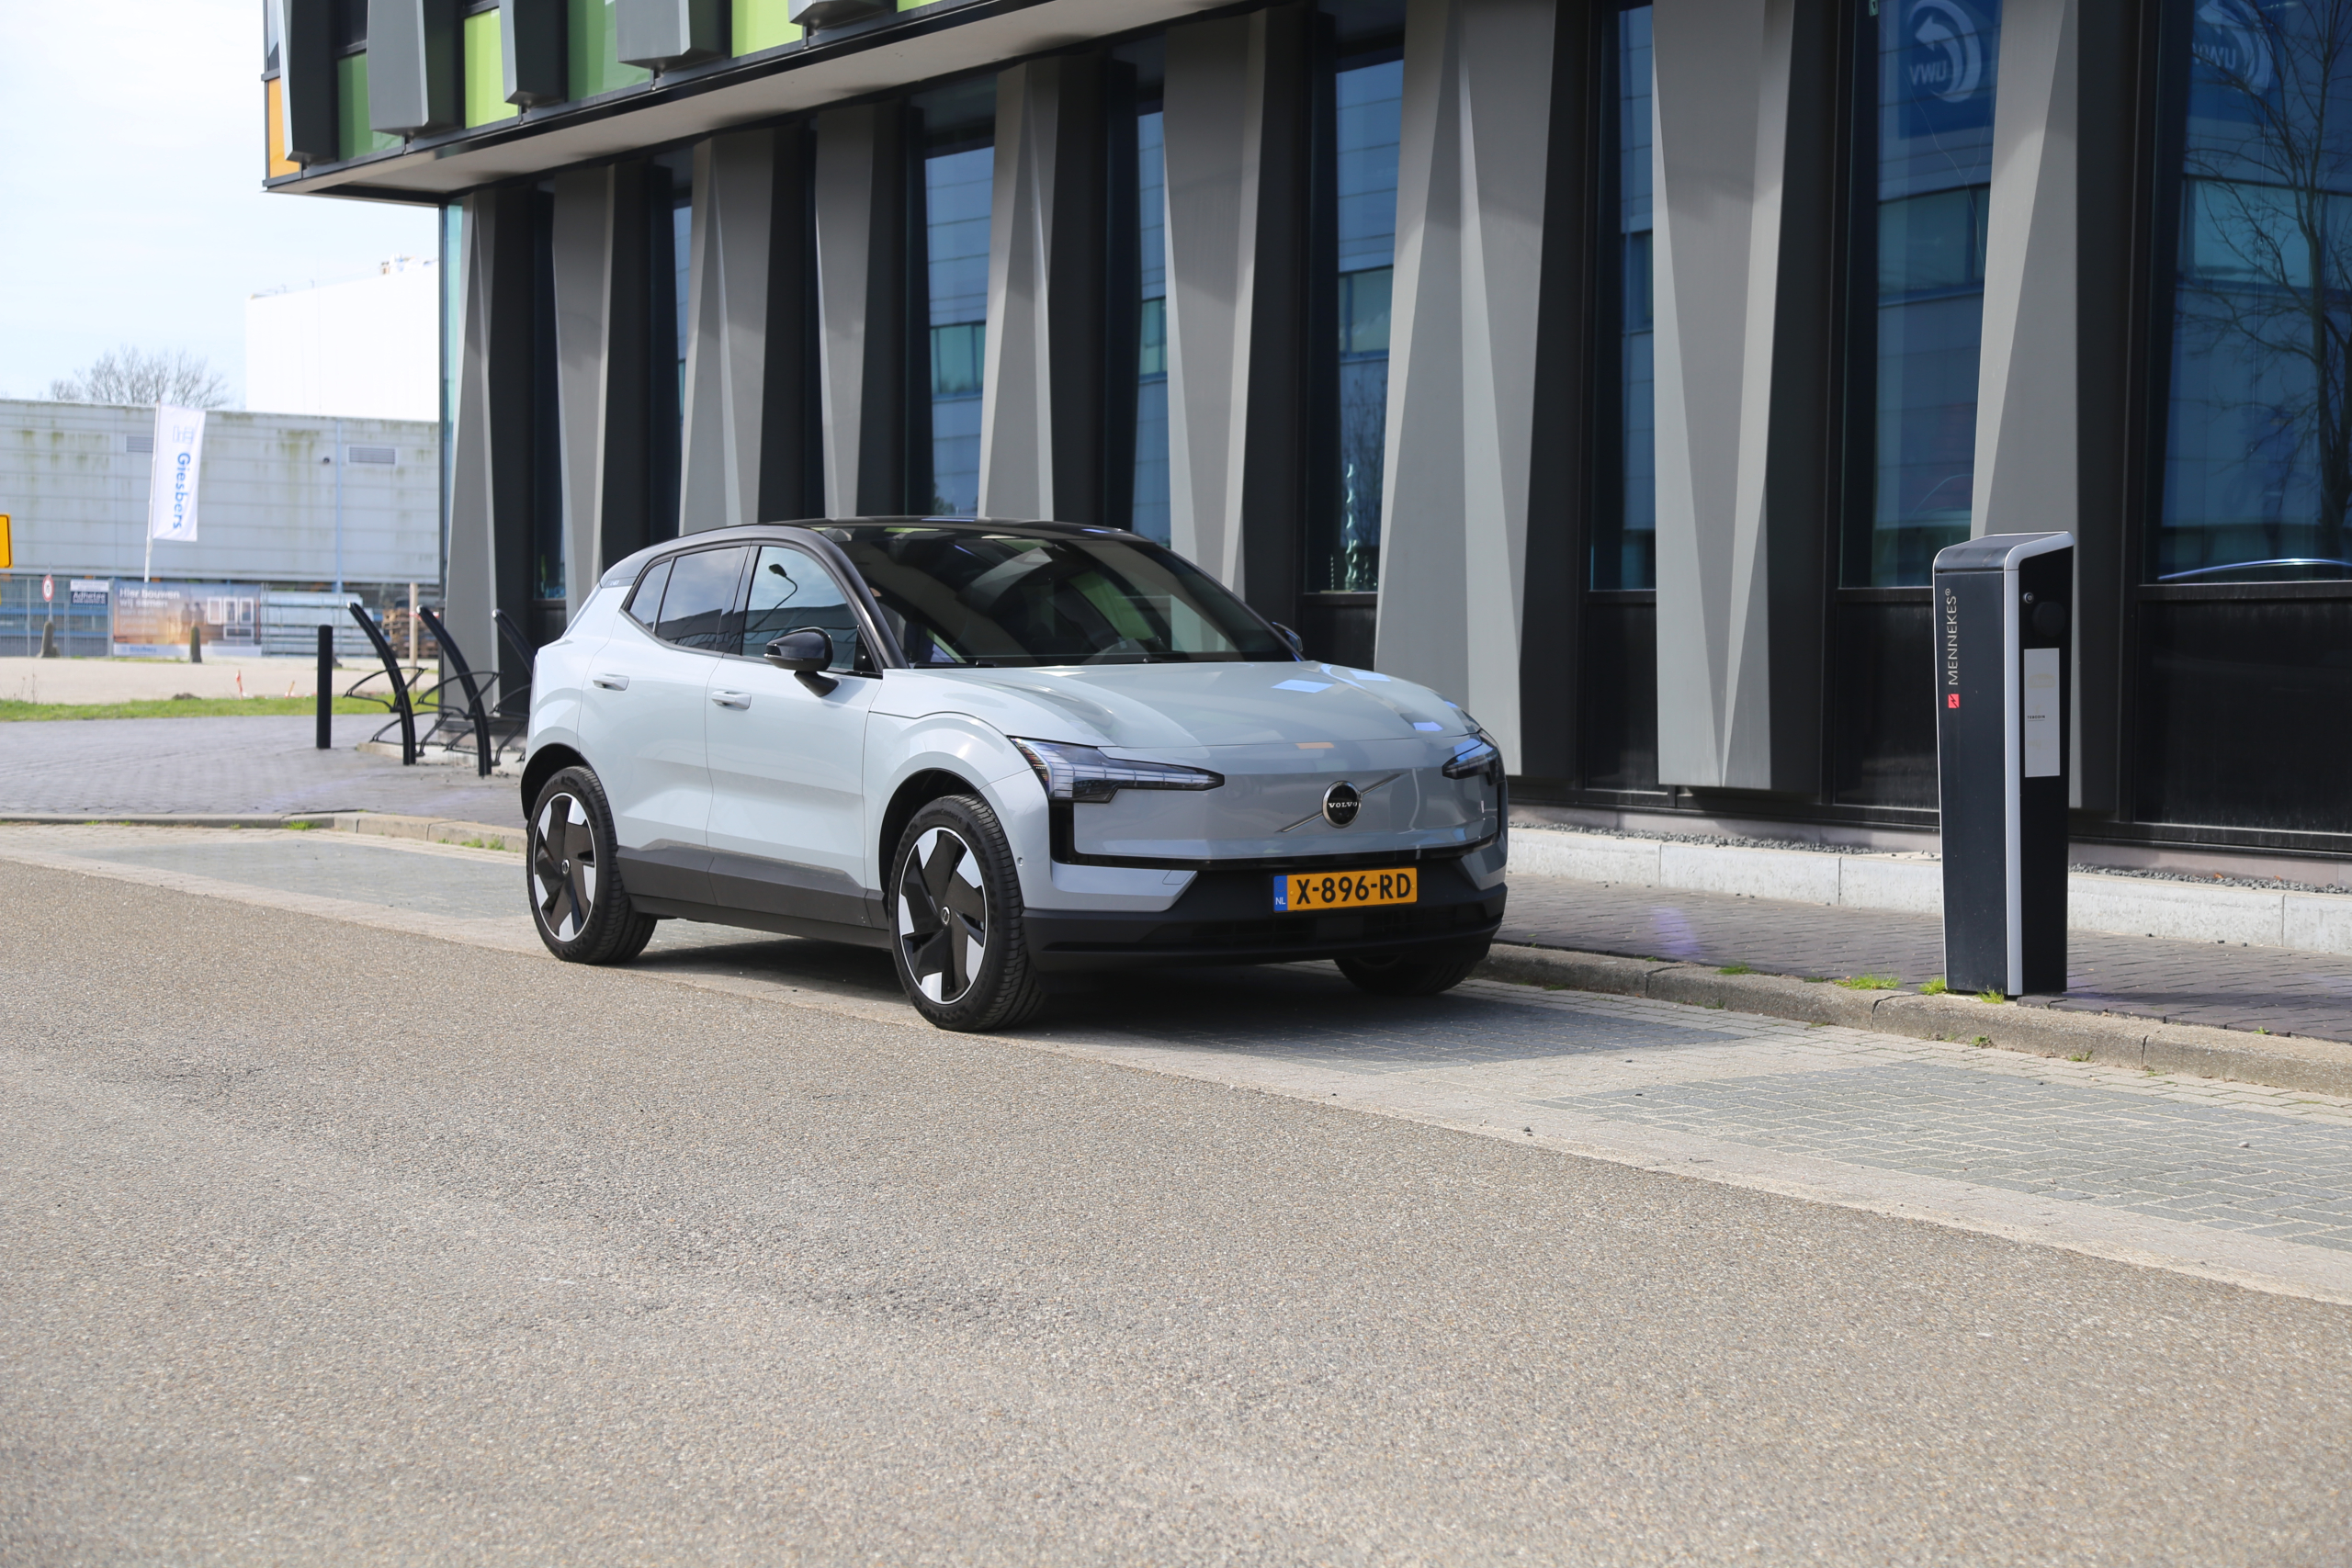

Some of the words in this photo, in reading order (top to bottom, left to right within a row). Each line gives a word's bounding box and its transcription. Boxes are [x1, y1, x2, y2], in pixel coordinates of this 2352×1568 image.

[173, 452, 191, 529] Giesbers
[119, 588, 139, 598] Hier
[141, 589, 180, 600] bouwen
[136, 600, 167, 608] samen
[1295, 873, 1411, 905] X-896-RD
[1275, 897, 1286, 906] NL
